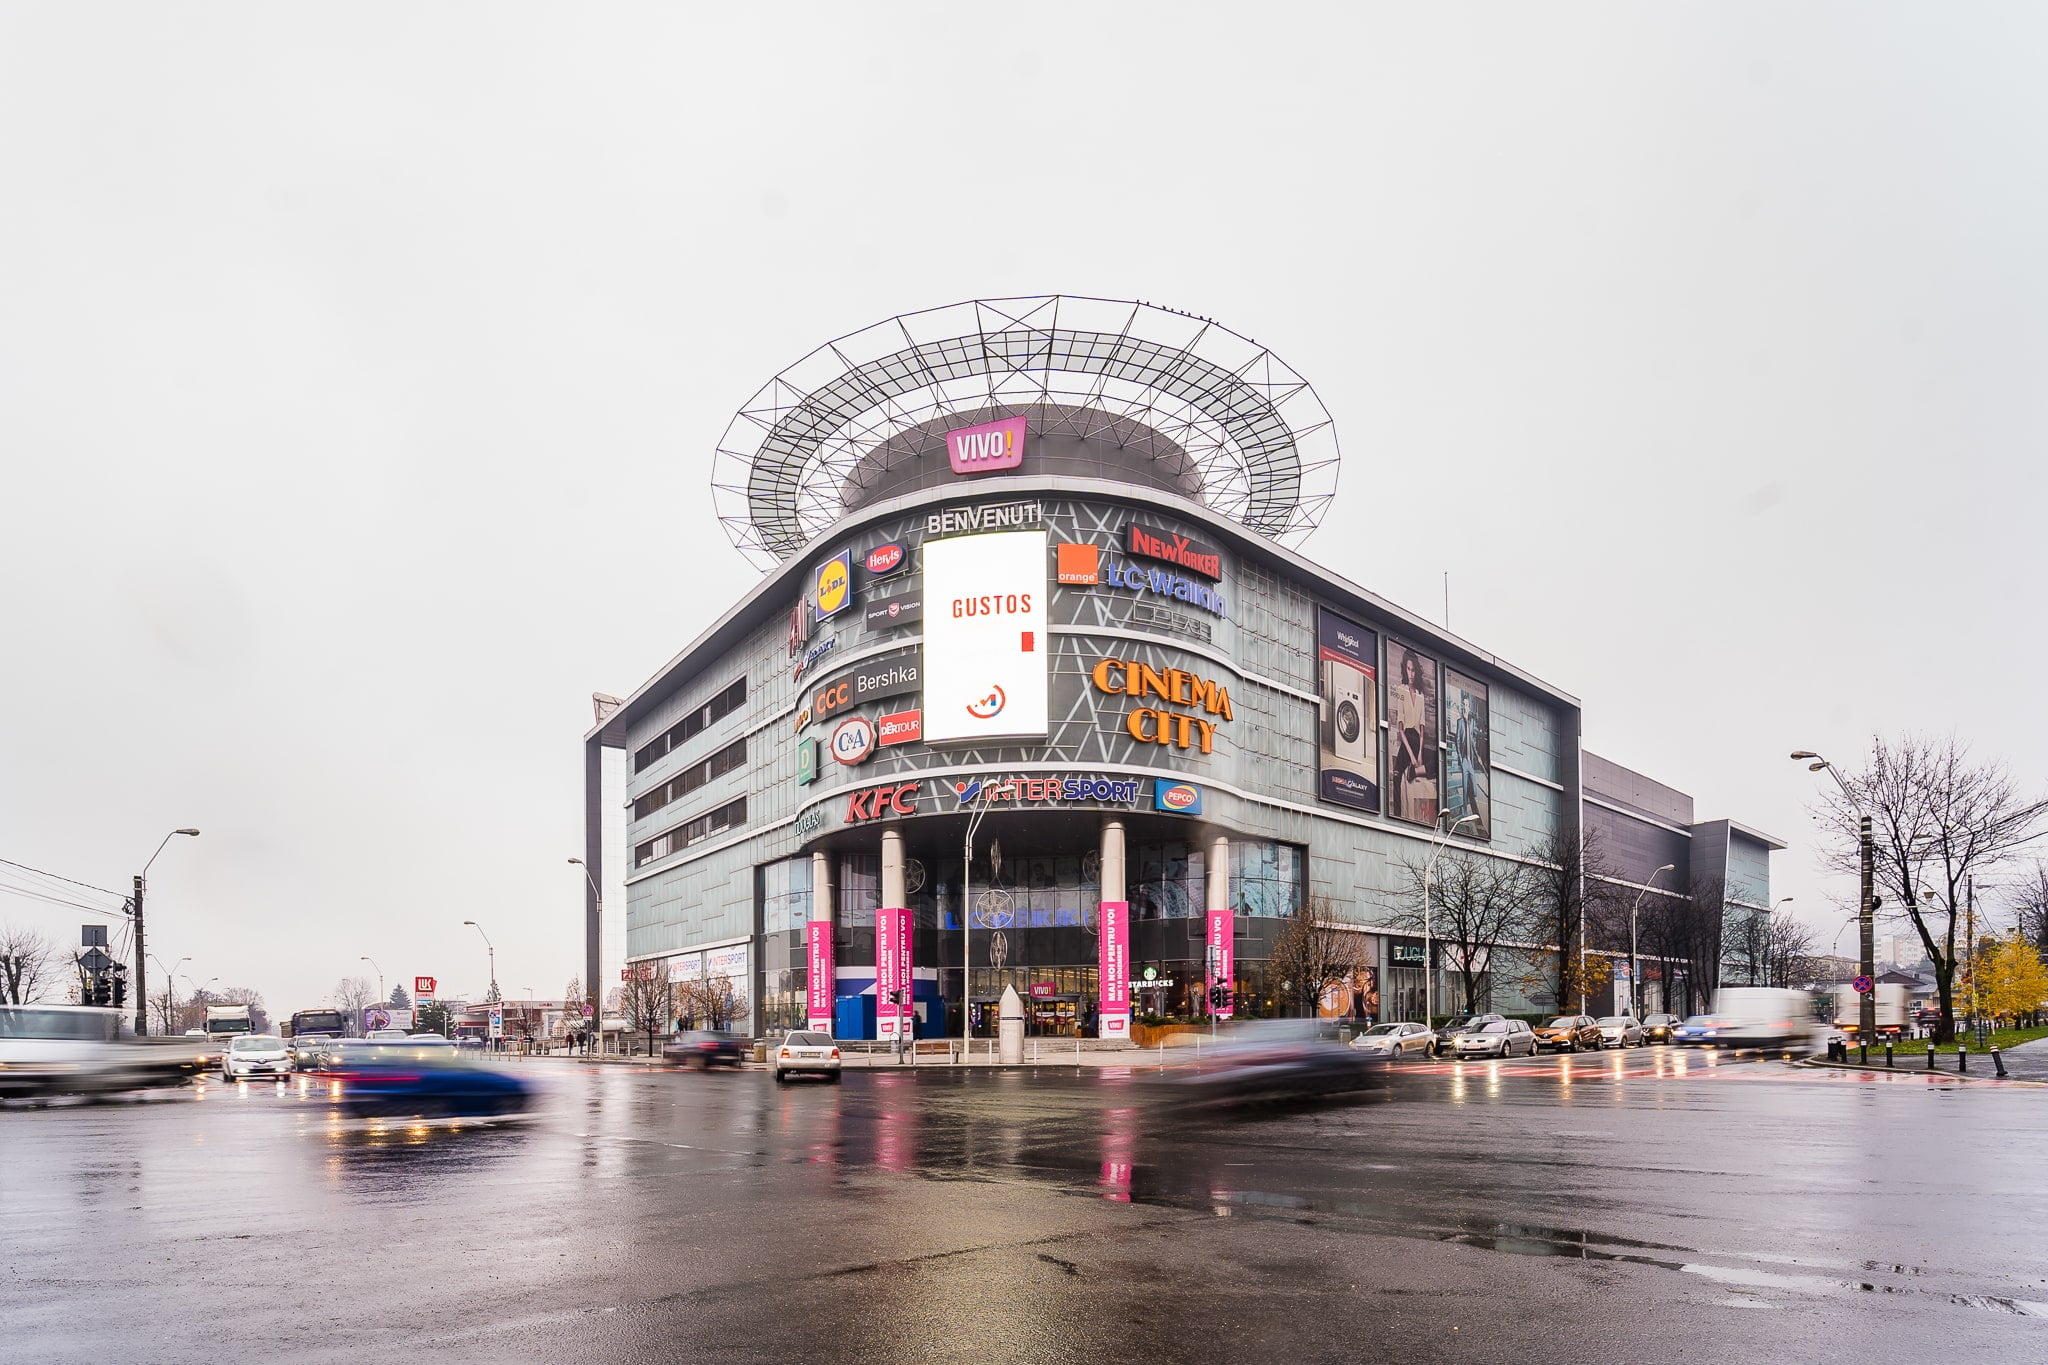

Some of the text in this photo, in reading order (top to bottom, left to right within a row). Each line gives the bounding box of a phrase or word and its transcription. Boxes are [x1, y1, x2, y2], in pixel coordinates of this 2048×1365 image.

[956, 430, 1013, 462] VIVO!
[928, 503, 1042, 534] BENVENUTI
[869, 550, 900, 568] Hervis
[1108, 563, 1145, 590] LC
[867, 601, 921, 619] SPORT VISION
[952, 593, 1032, 619] GUSTOS
[857, 666, 917, 693] Bershka
[1092, 658, 1234, 721] CINEMA
[816, 683, 849, 714] CCC
[838, 728, 866, 752] C&A
[1127, 707, 1217, 754] CITY
[844, 783, 919, 824] KFC
[1168, 791, 1192, 803] PEPCO
[1107, 909, 1115, 925] VOI
[1034, 986, 1052, 995] VIVO!
[1108, 983, 1116, 1001] MAI
